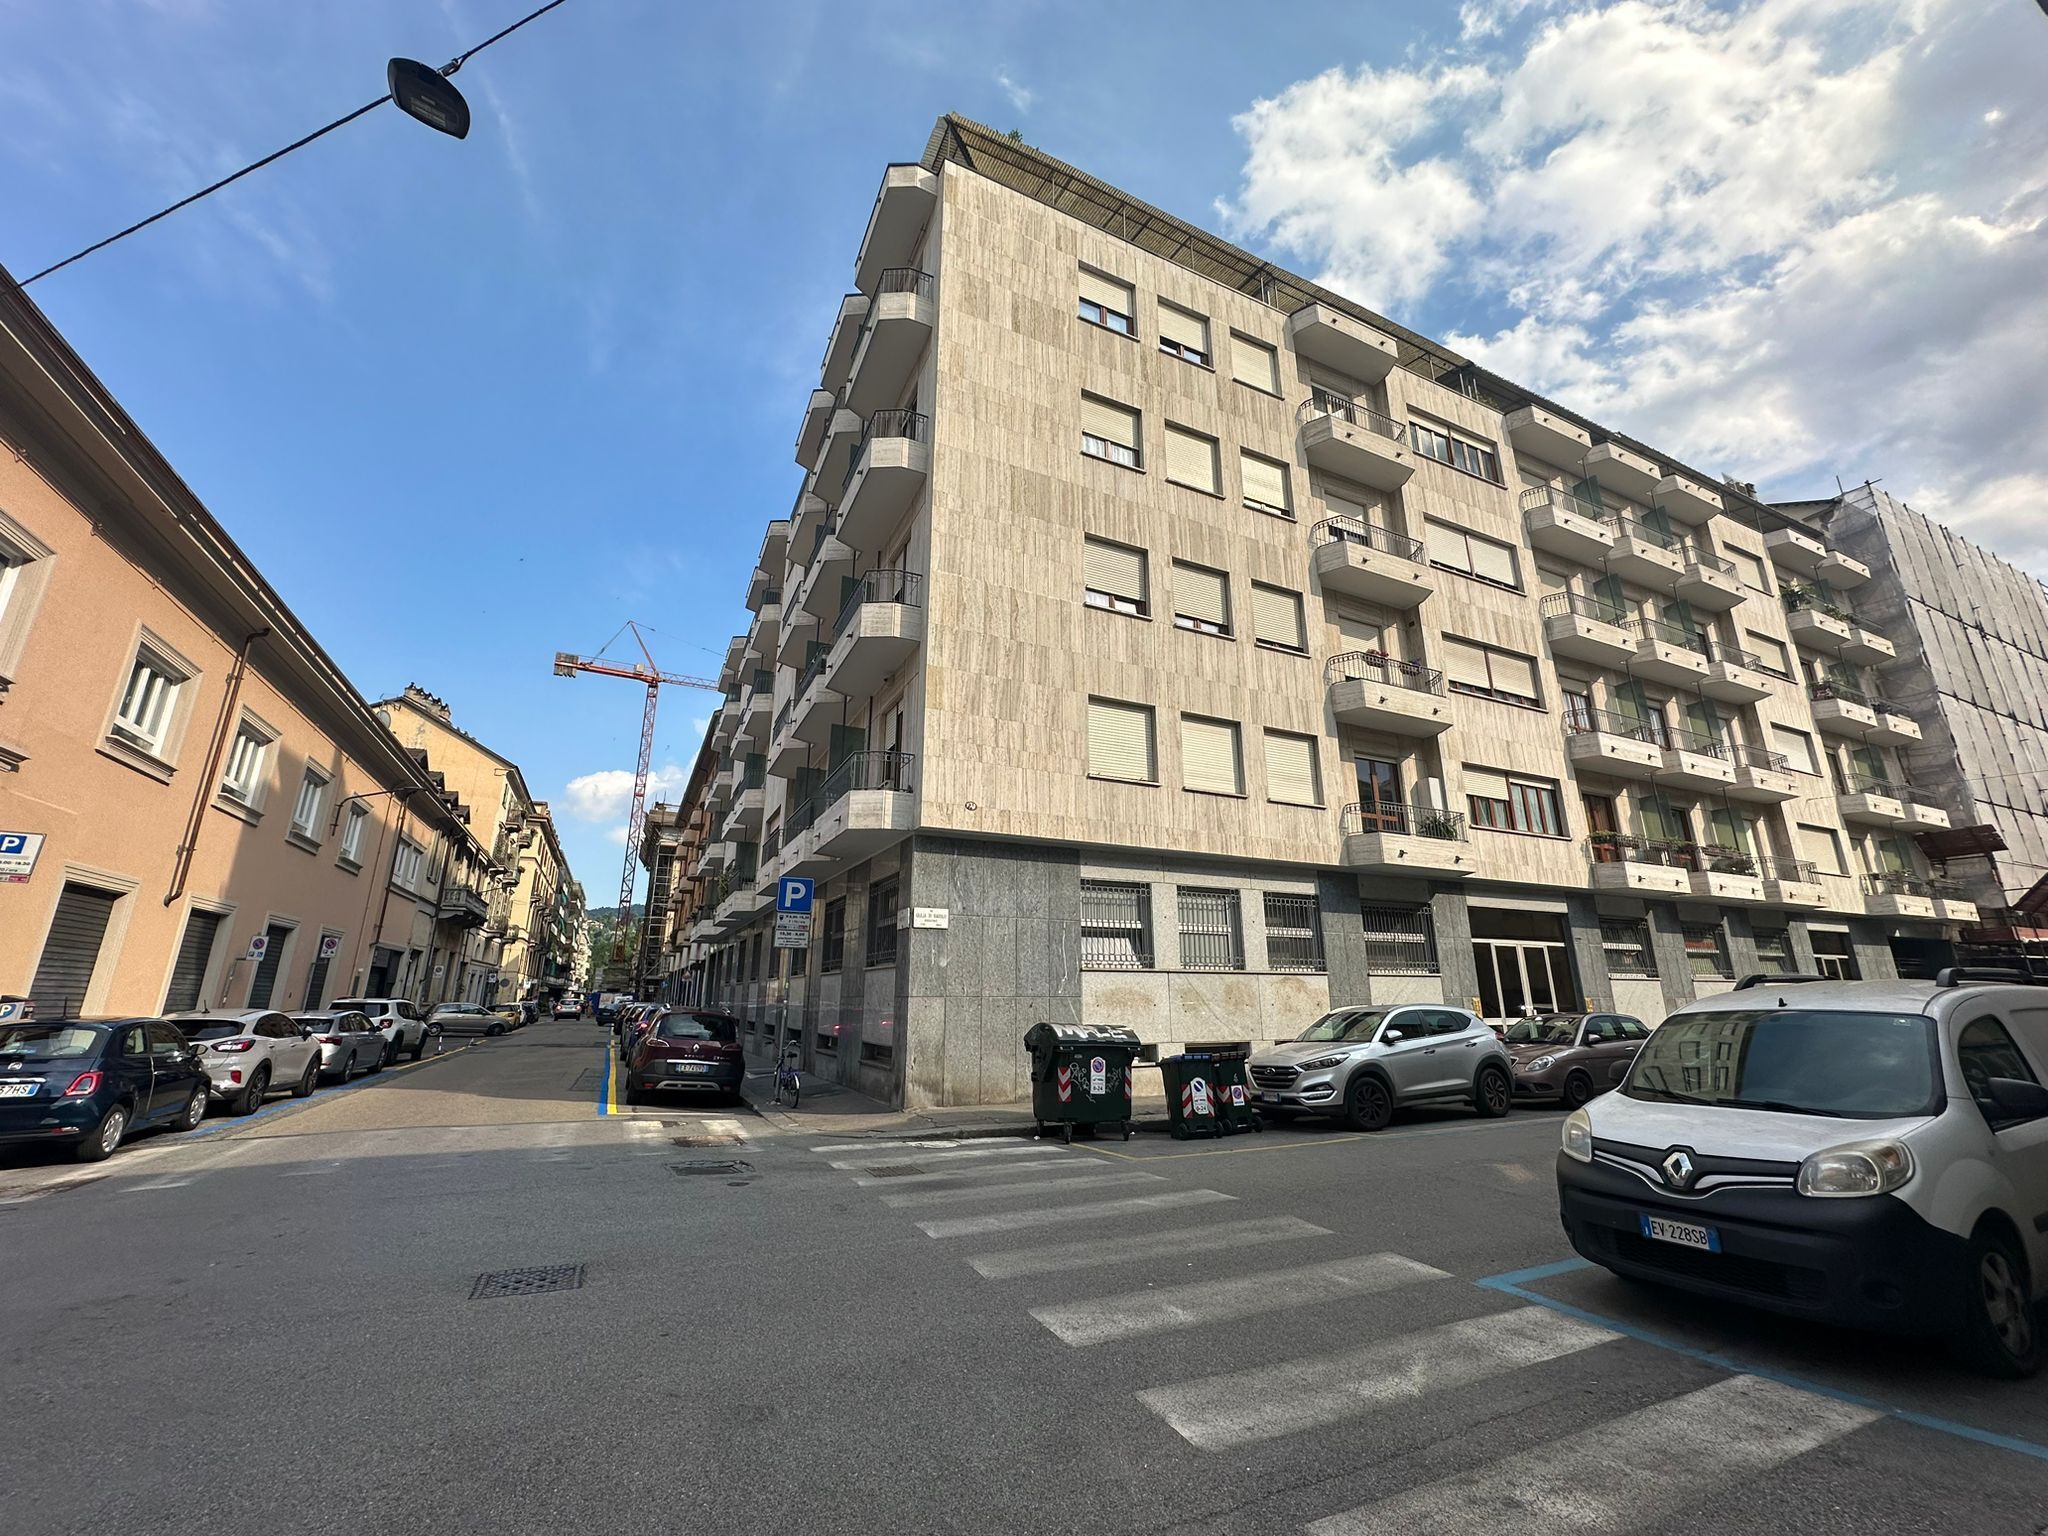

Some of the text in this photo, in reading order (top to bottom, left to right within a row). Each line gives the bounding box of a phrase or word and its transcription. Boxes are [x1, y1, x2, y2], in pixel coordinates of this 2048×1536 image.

[1, 836, 20, 851] P
[785, 882, 806, 907] P
[1651, 1220, 1708, 1245] EV 228SB
